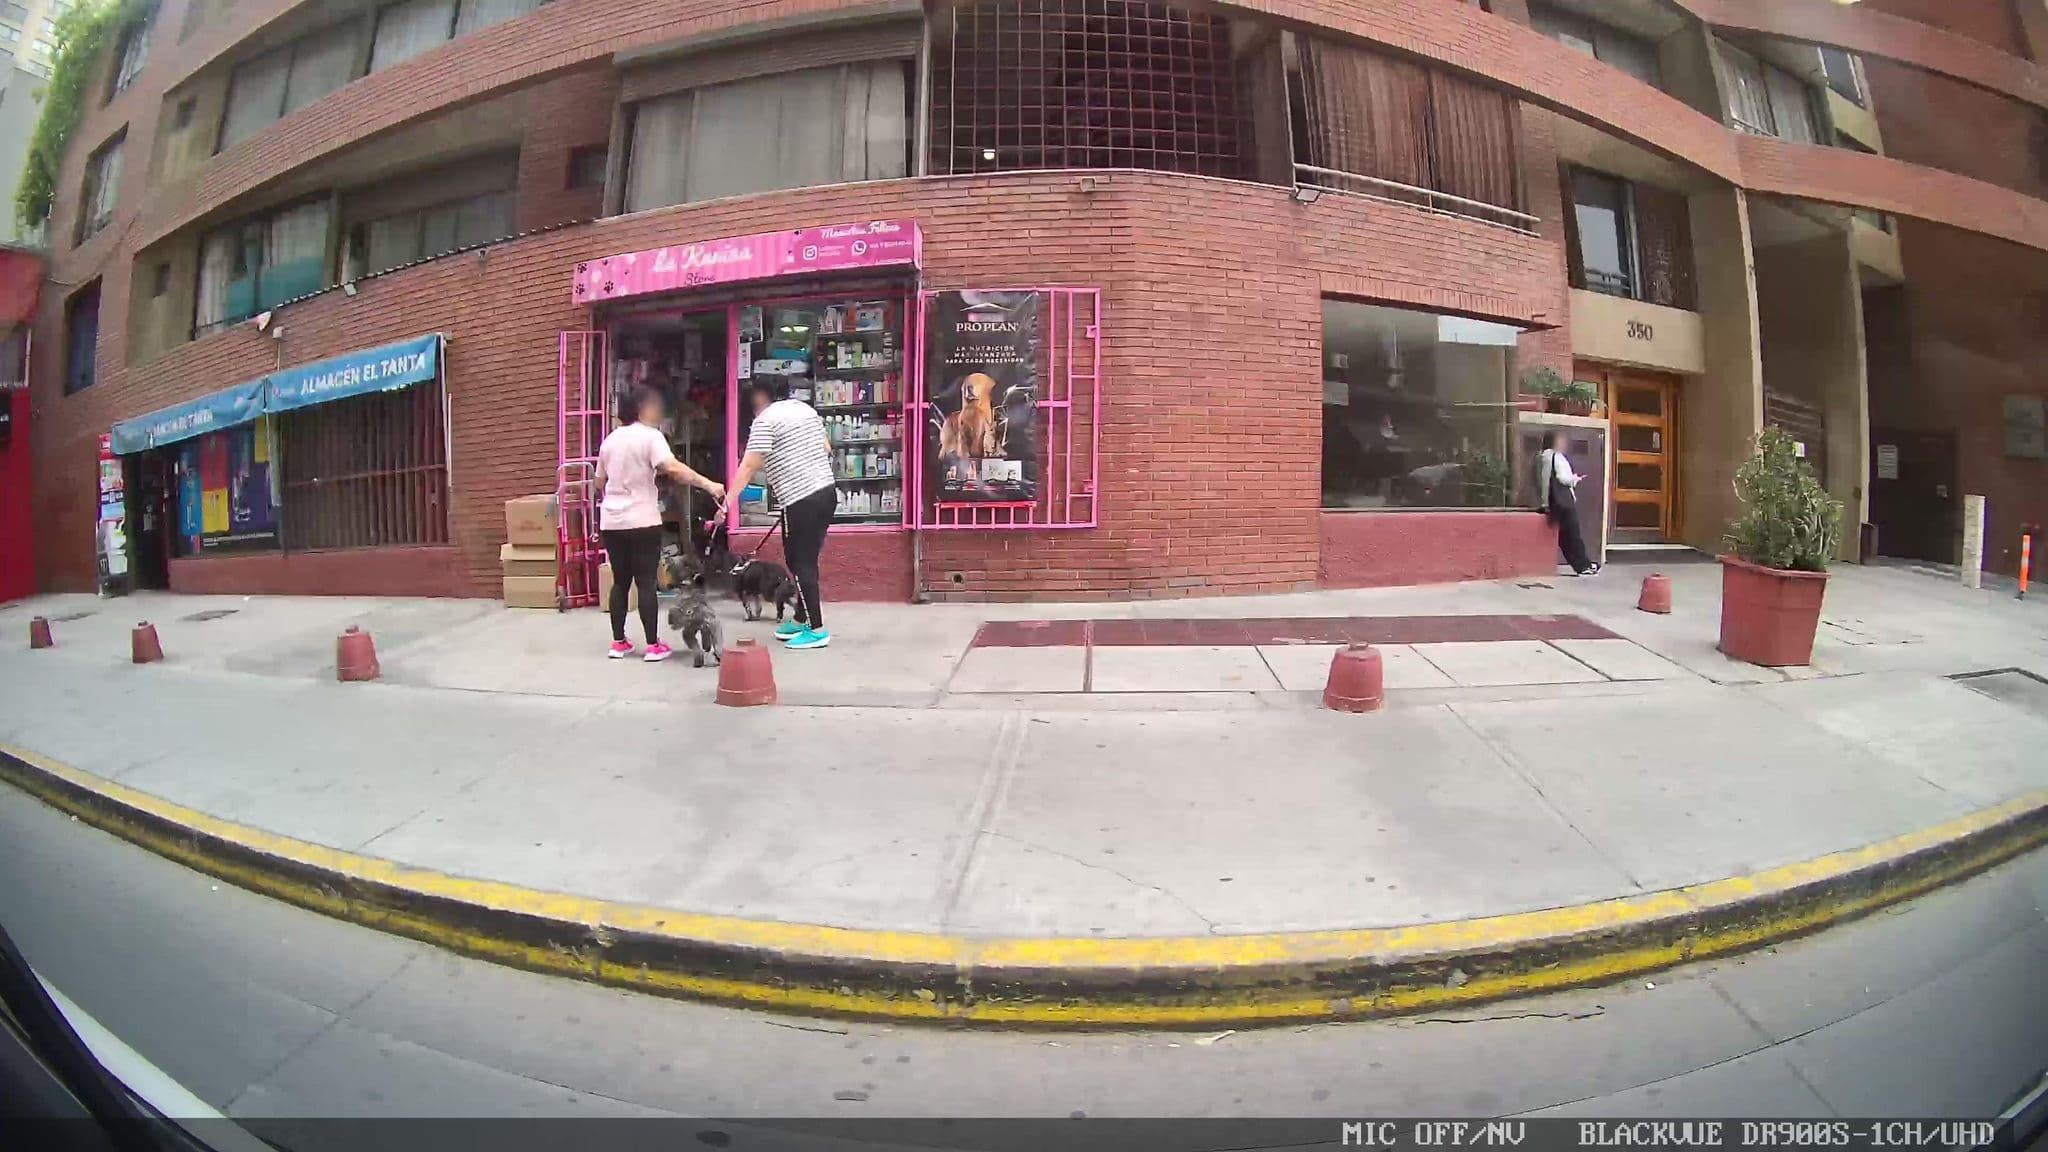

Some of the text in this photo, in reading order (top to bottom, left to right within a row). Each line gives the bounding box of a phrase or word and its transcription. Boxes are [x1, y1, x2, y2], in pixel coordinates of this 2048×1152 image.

[956, 322, 1017, 332] PRO PLAN
[1627, 320, 1653, 341] 350
[363, 363, 379, 381] EL
[380, 352, 426, 377] TANTA
